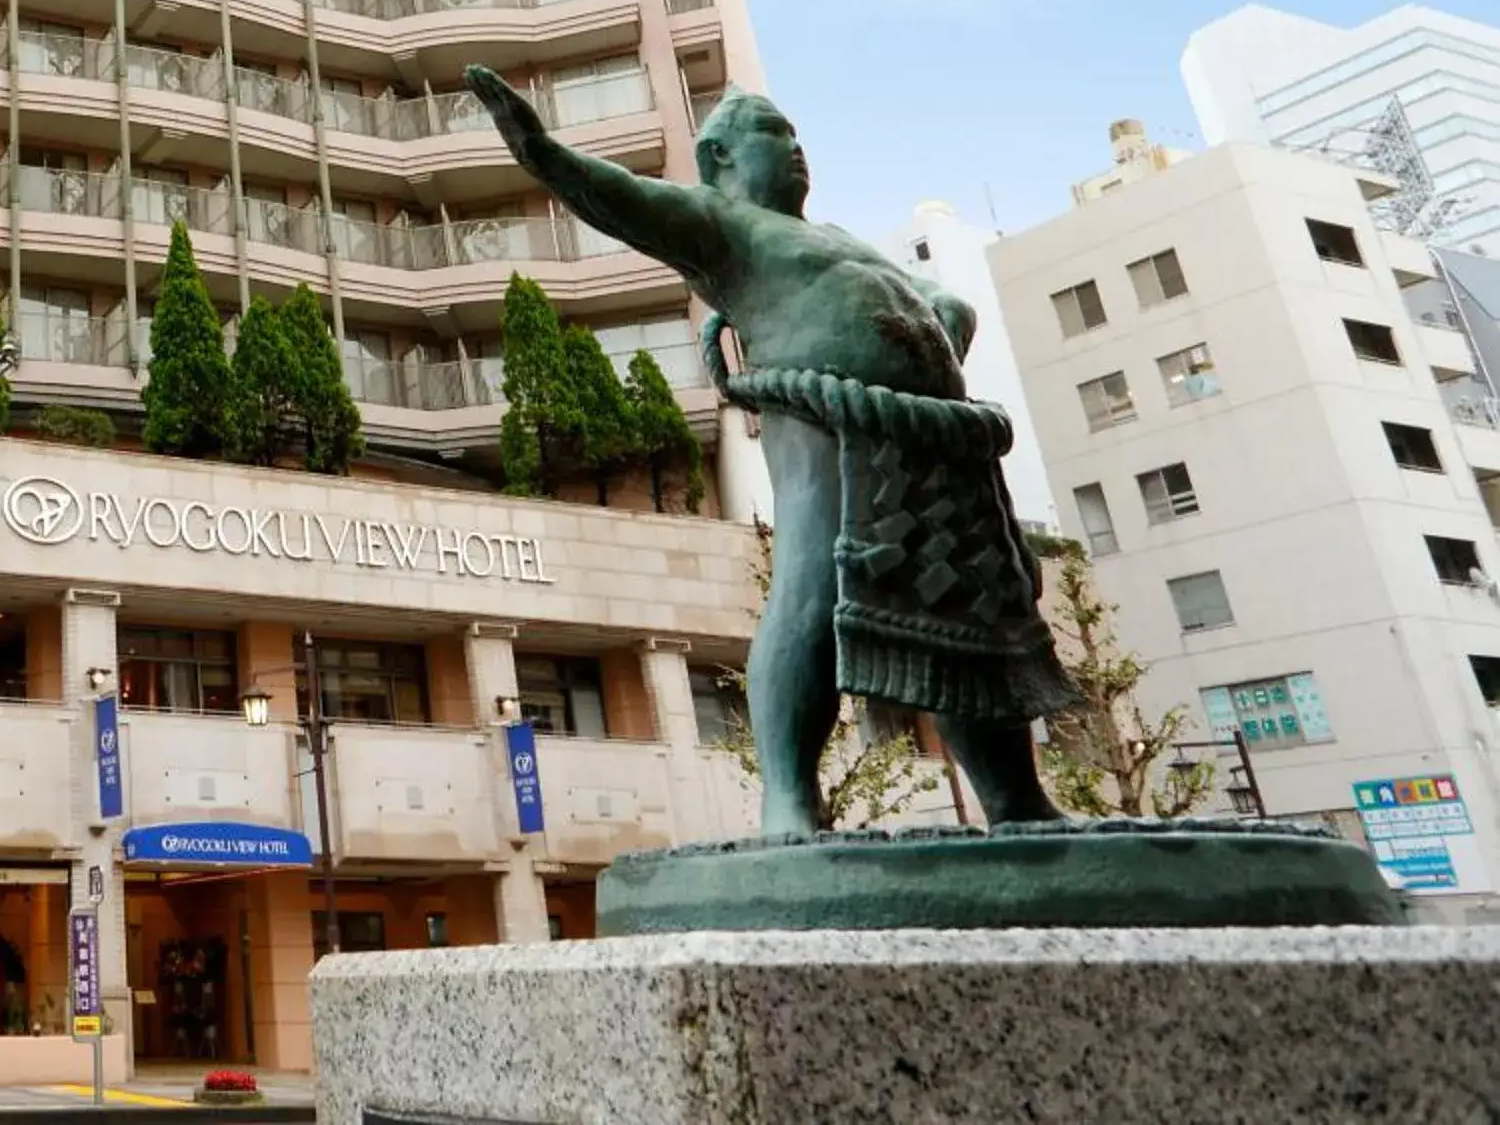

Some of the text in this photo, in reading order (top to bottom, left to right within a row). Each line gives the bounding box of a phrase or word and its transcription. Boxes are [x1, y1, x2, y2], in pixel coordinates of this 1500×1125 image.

[87, 492, 557, 585] RYOGOKU VIEW HOTEL
